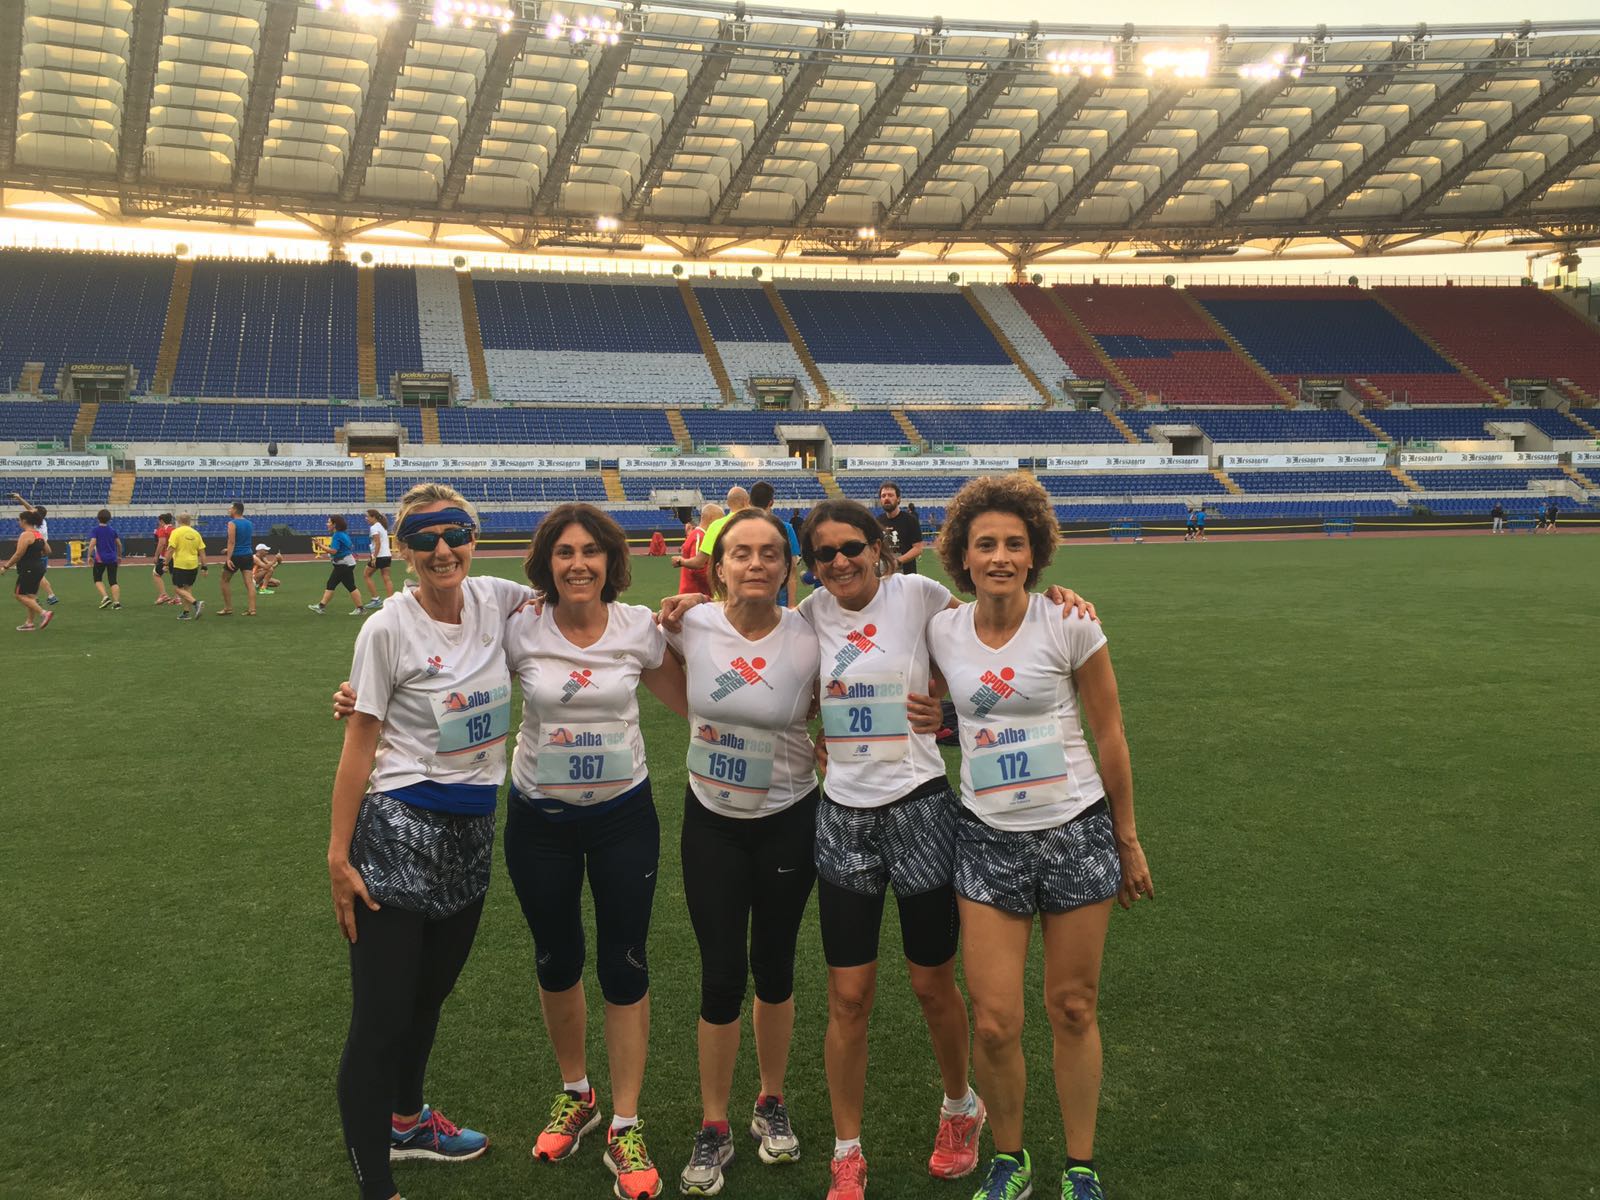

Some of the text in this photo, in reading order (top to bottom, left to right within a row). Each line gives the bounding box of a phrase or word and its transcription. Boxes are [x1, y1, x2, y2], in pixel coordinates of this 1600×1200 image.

[57, 458, 100, 467] Messaggero
[154, 458, 194, 467] Messaggero
[208, 458, 248, 467] Messaggero
[262, 458, 302, 467] Messaggero
[315, 458, 354, 467] Messaggero
[401, 459, 438, 468] Messaggero
[450, 459, 487, 468] Messaggero
[498, 459, 534, 468] Messaggero
[546, 459, 580, 467] Messaggero
[634, 459, 667, 467] Messaggero
[679, 459, 711, 467] Messaggero
[722, 459, 754, 467] Messaggero
[766, 459, 797, 467] Messaggero
[857, 459, 888, 467] Messaggero
[898, 458, 930, 467] Messaggero
[940, 458, 970, 466] Messaggero
[980, 458, 1009, 466] Messaggero
[846, 630, 876, 654] SPORT
[834, 643, 855, 662] SENZA
[715, 669, 740, 686] SENZA
[730, 656, 763, 686] SPORT
[569, 671, 591, 688] SPORT
[980, 670, 1016, 699] SPORT
[467, 685, 508, 708] albarace
[710, 677, 748, 702] FRONTIERE
[848, 683, 904, 699] albarace
[969, 684, 992, 706] SENZA
[849, 706, 873, 733] 26
[466, 713, 492, 743] 152
[997, 723, 1057, 745] albarace
[575, 732, 625, 747] albarace
[720, 733, 772, 753] albarace
[569, 755, 605, 780] 367
[708, 753, 747, 782] 1519
[997, 751, 1031, 781] 172
